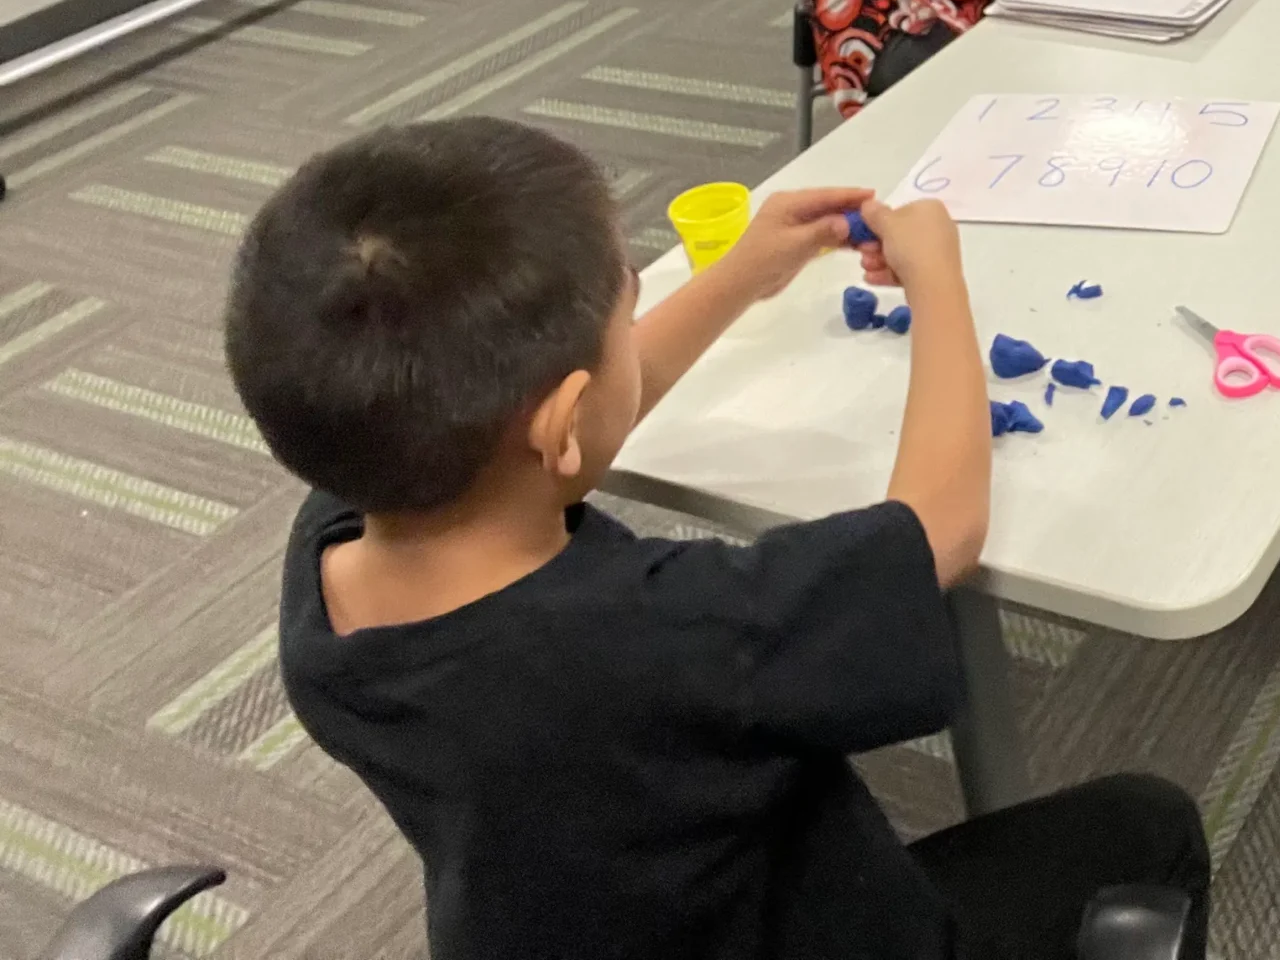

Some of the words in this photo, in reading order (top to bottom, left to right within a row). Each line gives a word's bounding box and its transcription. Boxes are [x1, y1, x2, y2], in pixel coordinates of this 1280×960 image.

[978, 98, 998, 122] 1
[1026, 98, 1061, 121] 2
[1198, 102, 1250, 127] 5
[913, 156, 951, 193] 6
[987, 155, 1024, 190] 7
[1037, 155, 1077, 188] 8
[1098, 156, 1127, 188] 9
[1147, 158, 1213, 189] 10
